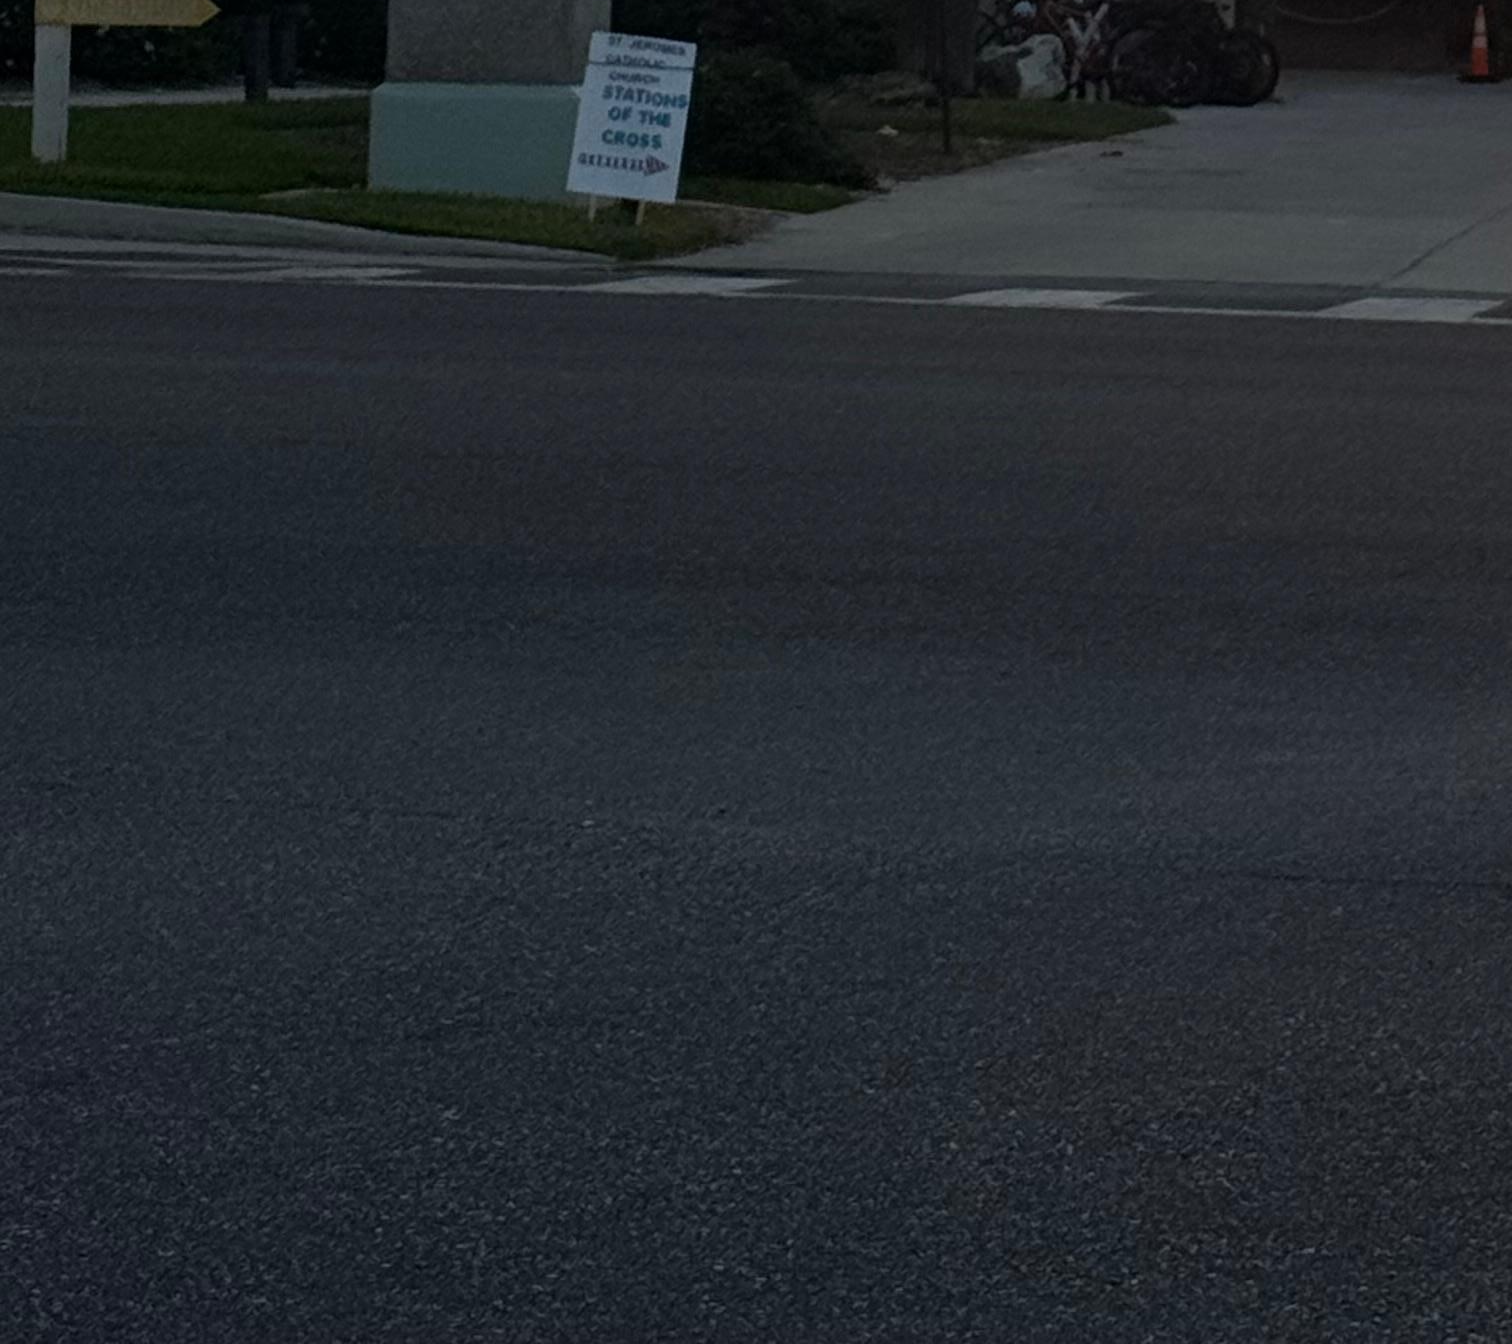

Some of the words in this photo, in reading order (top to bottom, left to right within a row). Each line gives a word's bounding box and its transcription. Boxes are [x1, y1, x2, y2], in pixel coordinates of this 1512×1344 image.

[602, 84, 688, 109] STATIONS
[608, 106, 632, 121] OF
[639, 110, 671, 128] THE
[602, 128, 663, 150] CROSS
